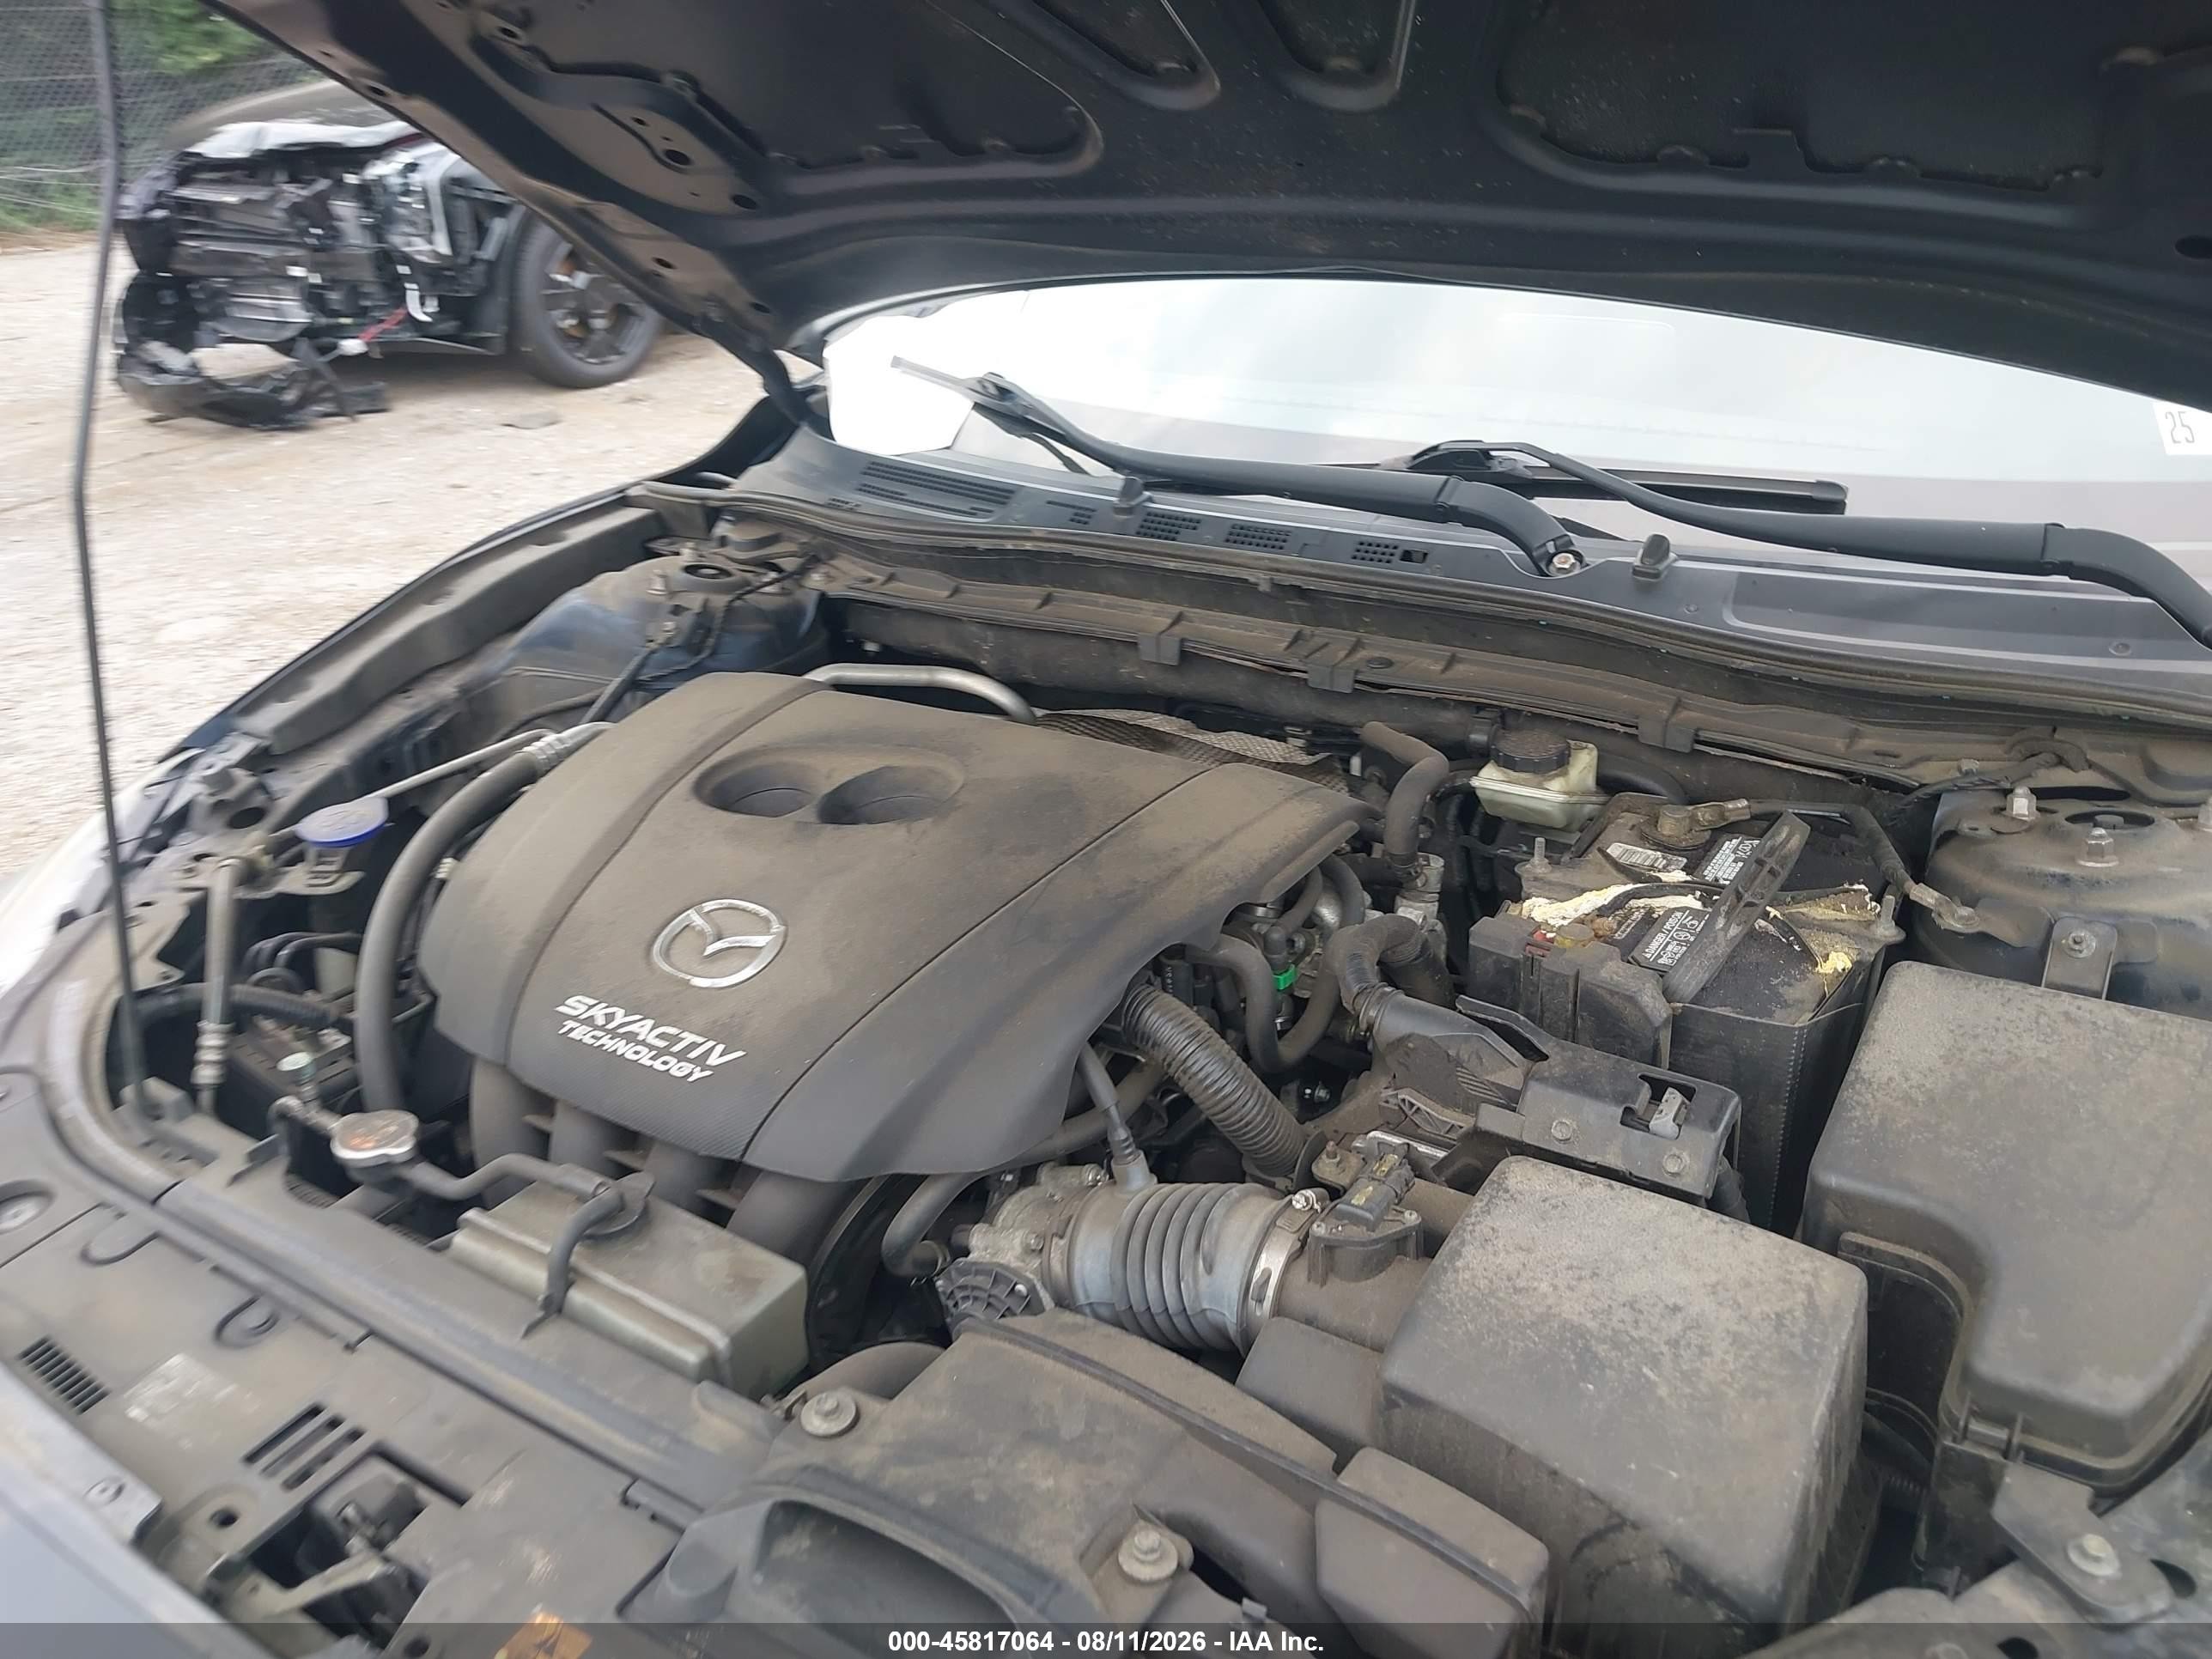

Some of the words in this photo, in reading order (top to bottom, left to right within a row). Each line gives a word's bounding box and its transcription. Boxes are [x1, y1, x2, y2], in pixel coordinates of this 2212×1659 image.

[2165, 410, 2195, 444] 25
[1644, 933, 1668, 954] DANGER
[1663, 910, 1684, 930] POISON
[554, 994, 748, 1067] SKYACTIV
[557, 1019, 714, 1083] TECHNOLOGY
